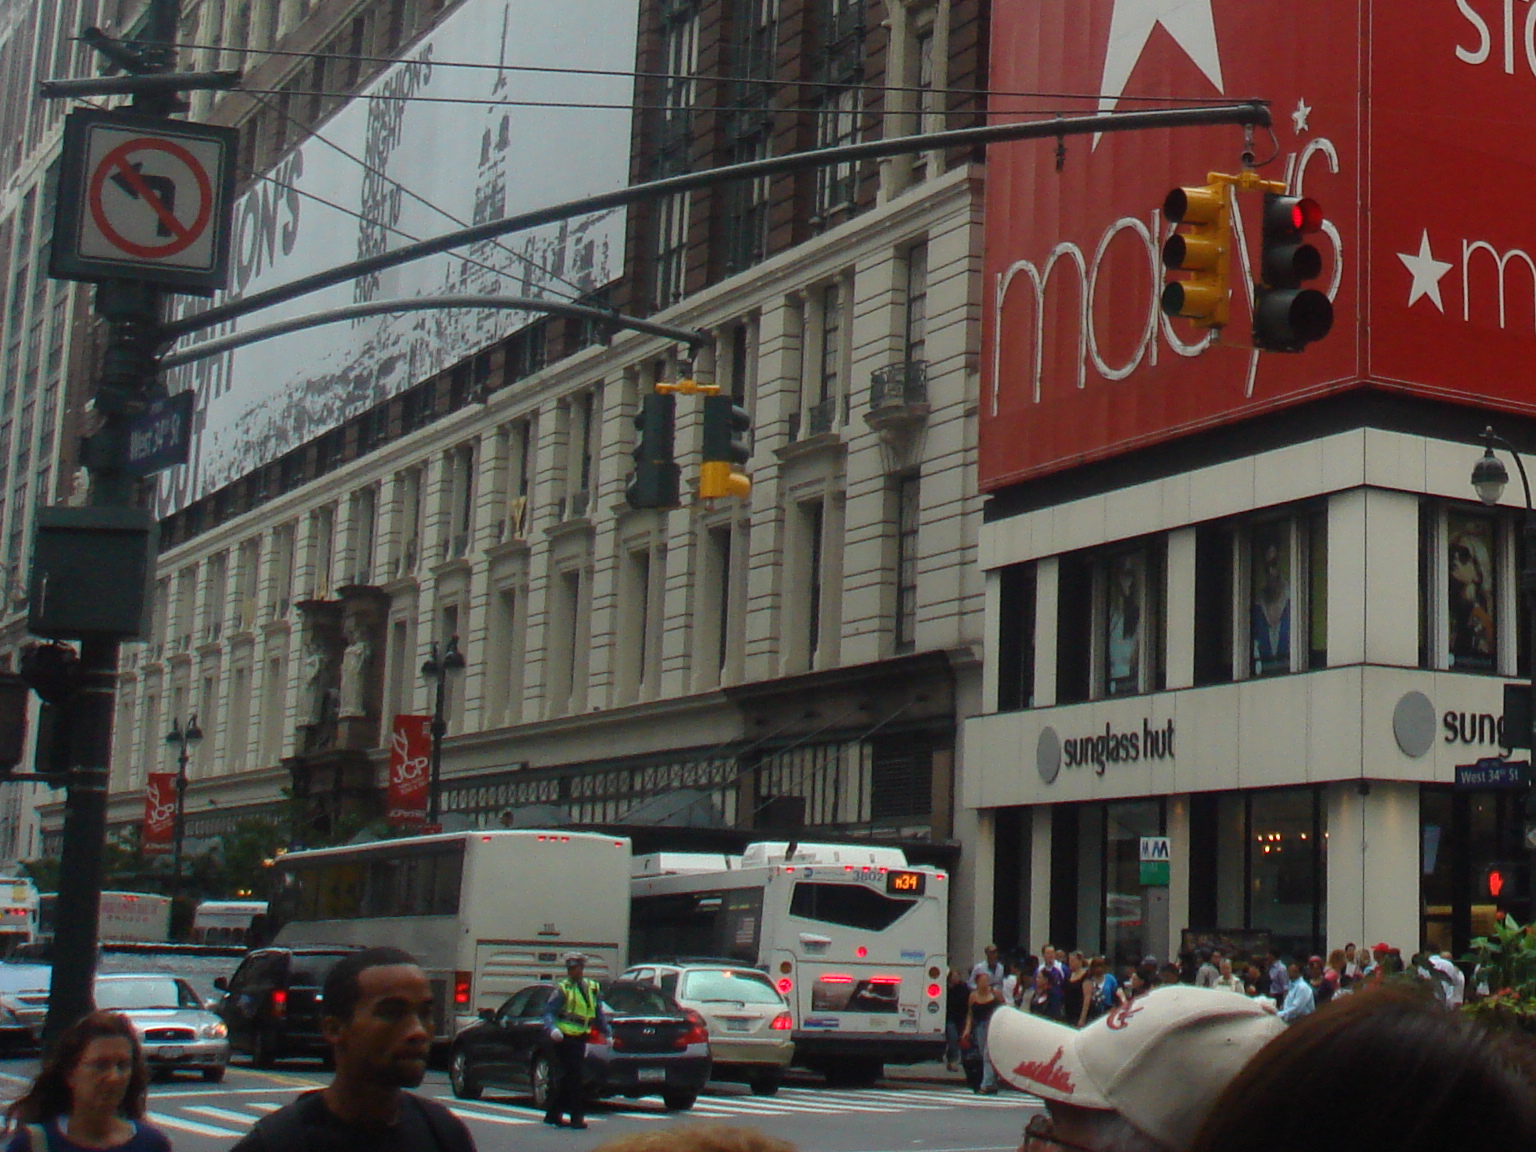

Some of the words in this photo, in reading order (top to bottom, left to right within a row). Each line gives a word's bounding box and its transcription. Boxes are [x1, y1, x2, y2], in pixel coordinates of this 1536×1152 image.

[1064, 721, 1140, 776] sunglass
[1144, 717, 1175, 759] hut
[393, 757, 428, 783] JCP
[1460, 770, 1486, 784] West
[1488, 769, 1506, 782] 34th
[1508, 768, 1519, 781] St
